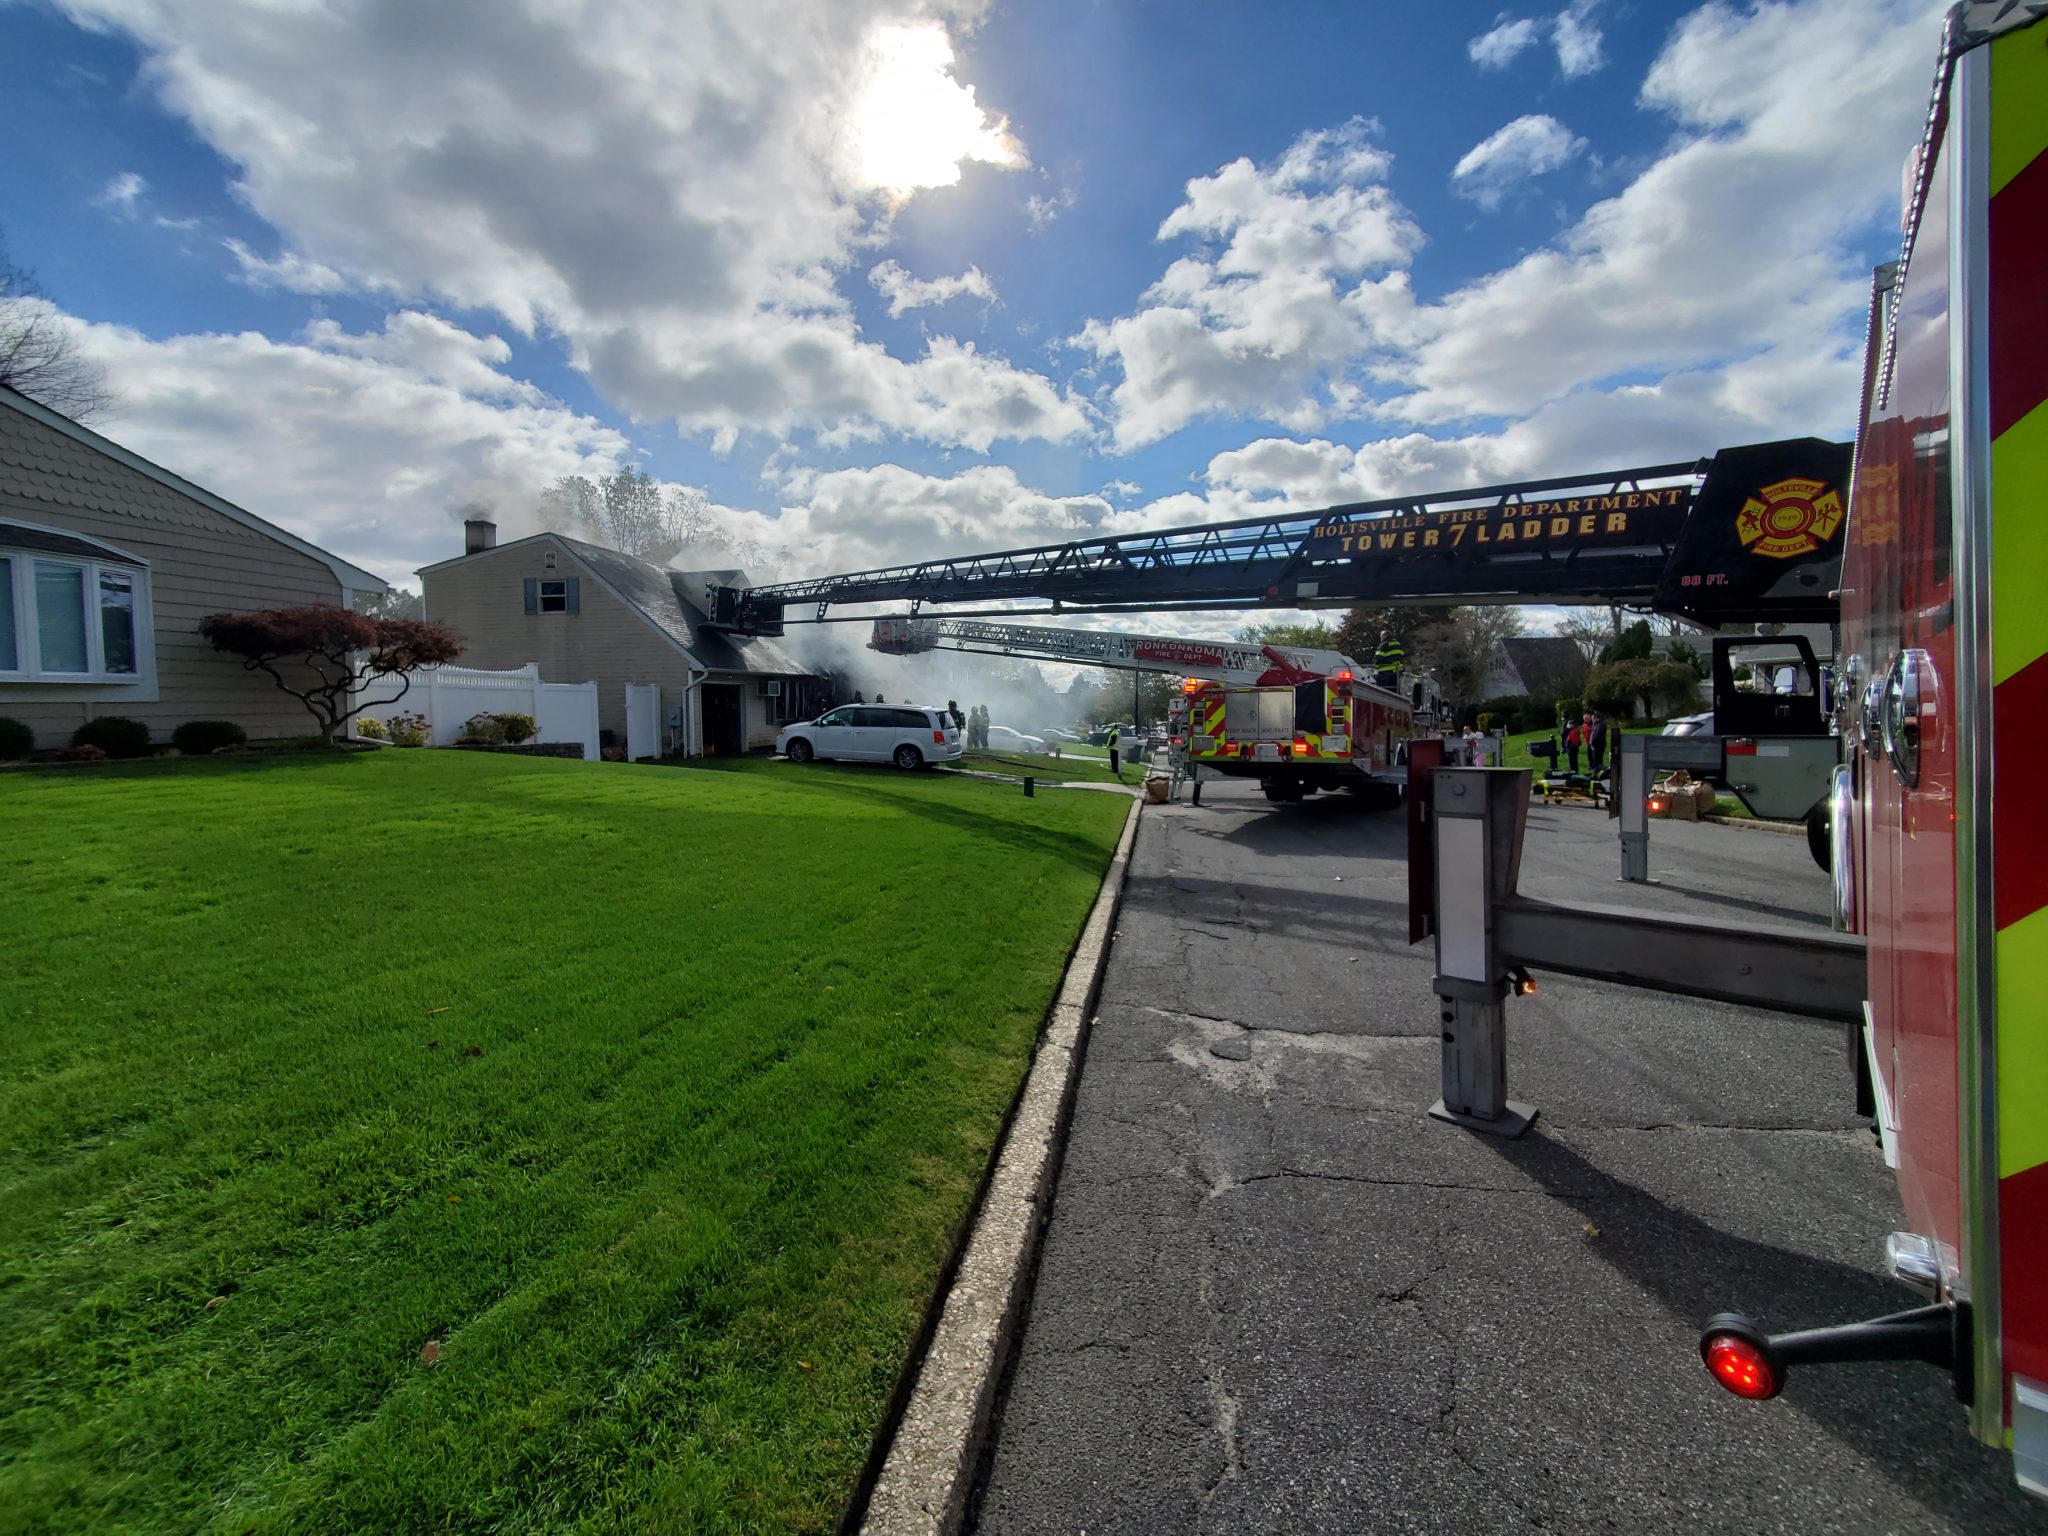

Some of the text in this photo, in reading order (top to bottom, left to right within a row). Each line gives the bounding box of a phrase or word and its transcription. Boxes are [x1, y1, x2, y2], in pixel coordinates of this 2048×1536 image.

[1314, 489, 1683, 538] HOLTSVILLE FIRE DEPARTMENT
[1777, 513, 1798, 522] 1929
[1341, 512, 1628, 552] TOWER 7 LADDER
[1758, 541, 1779, 552] FIRE
[1681, 573, 1729, 587] 88 FT.
[1135, 640, 1223, 659] RONKONKOMA
[1155, 650, 1202, 661] FIRE DEPT
